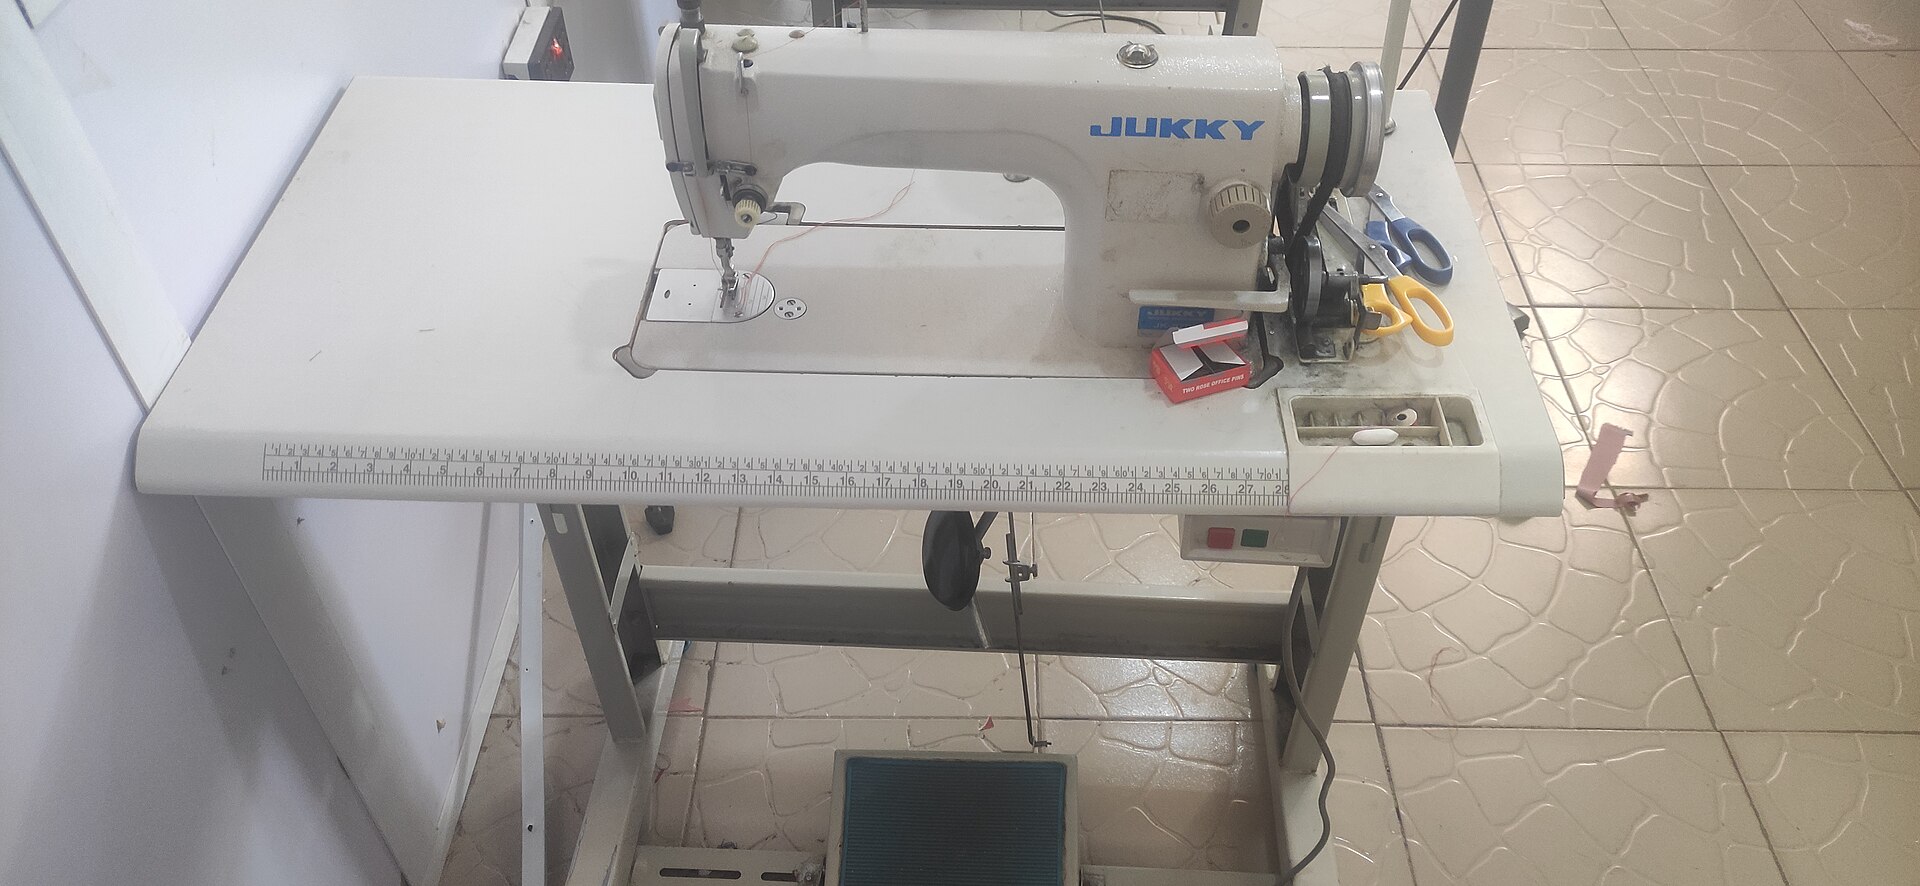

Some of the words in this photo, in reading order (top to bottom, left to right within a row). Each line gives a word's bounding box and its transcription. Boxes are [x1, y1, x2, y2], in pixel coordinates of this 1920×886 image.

[1090, 116, 1265, 140] JUKKY
[1211, 378, 1230, 386] OFFICE
[1232, 374, 1244, 382] PINS
[294, 461, 299, 469] 1
[330, 462, 336, 470] 2
[367, 463, 373, 472] 3
[403, 464, 409, 473] 4
[440, 465, 446, 474] 5
[476, 466, 483, 476] 6
[513, 467, 519, 476] 7
[549, 468, 556, 478] 8
[586, 469, 592, 479] 9
[623, 471, 638, 480] 10
[659, 472, 673, 481] 11
[695, 473, 710, 482] 12
[732, 474, 746, 483] 13
[768, 474, 783, 483] 14
[804, 476, 819, 485] 15
[840, 476, 855, 486] 16
[876, 477, 891, 486] 17
[912, 478, 927, 487] 18
[949, 479, 963, 488] 19
[984, 480, 998, 489] 20
[1019, 481, 1033, 490] 21
[1056, 481, 1071, 490] 22
[1092, 482, 1107, 491] 23
[1128, 482, 1143, 492] 24
[1165, 483, 1180, 492] 25
[1201, 484, 1217, 493] 26
[1238, 484, 1254, 493] 27
[1276, 485, 1289, 494] 28
